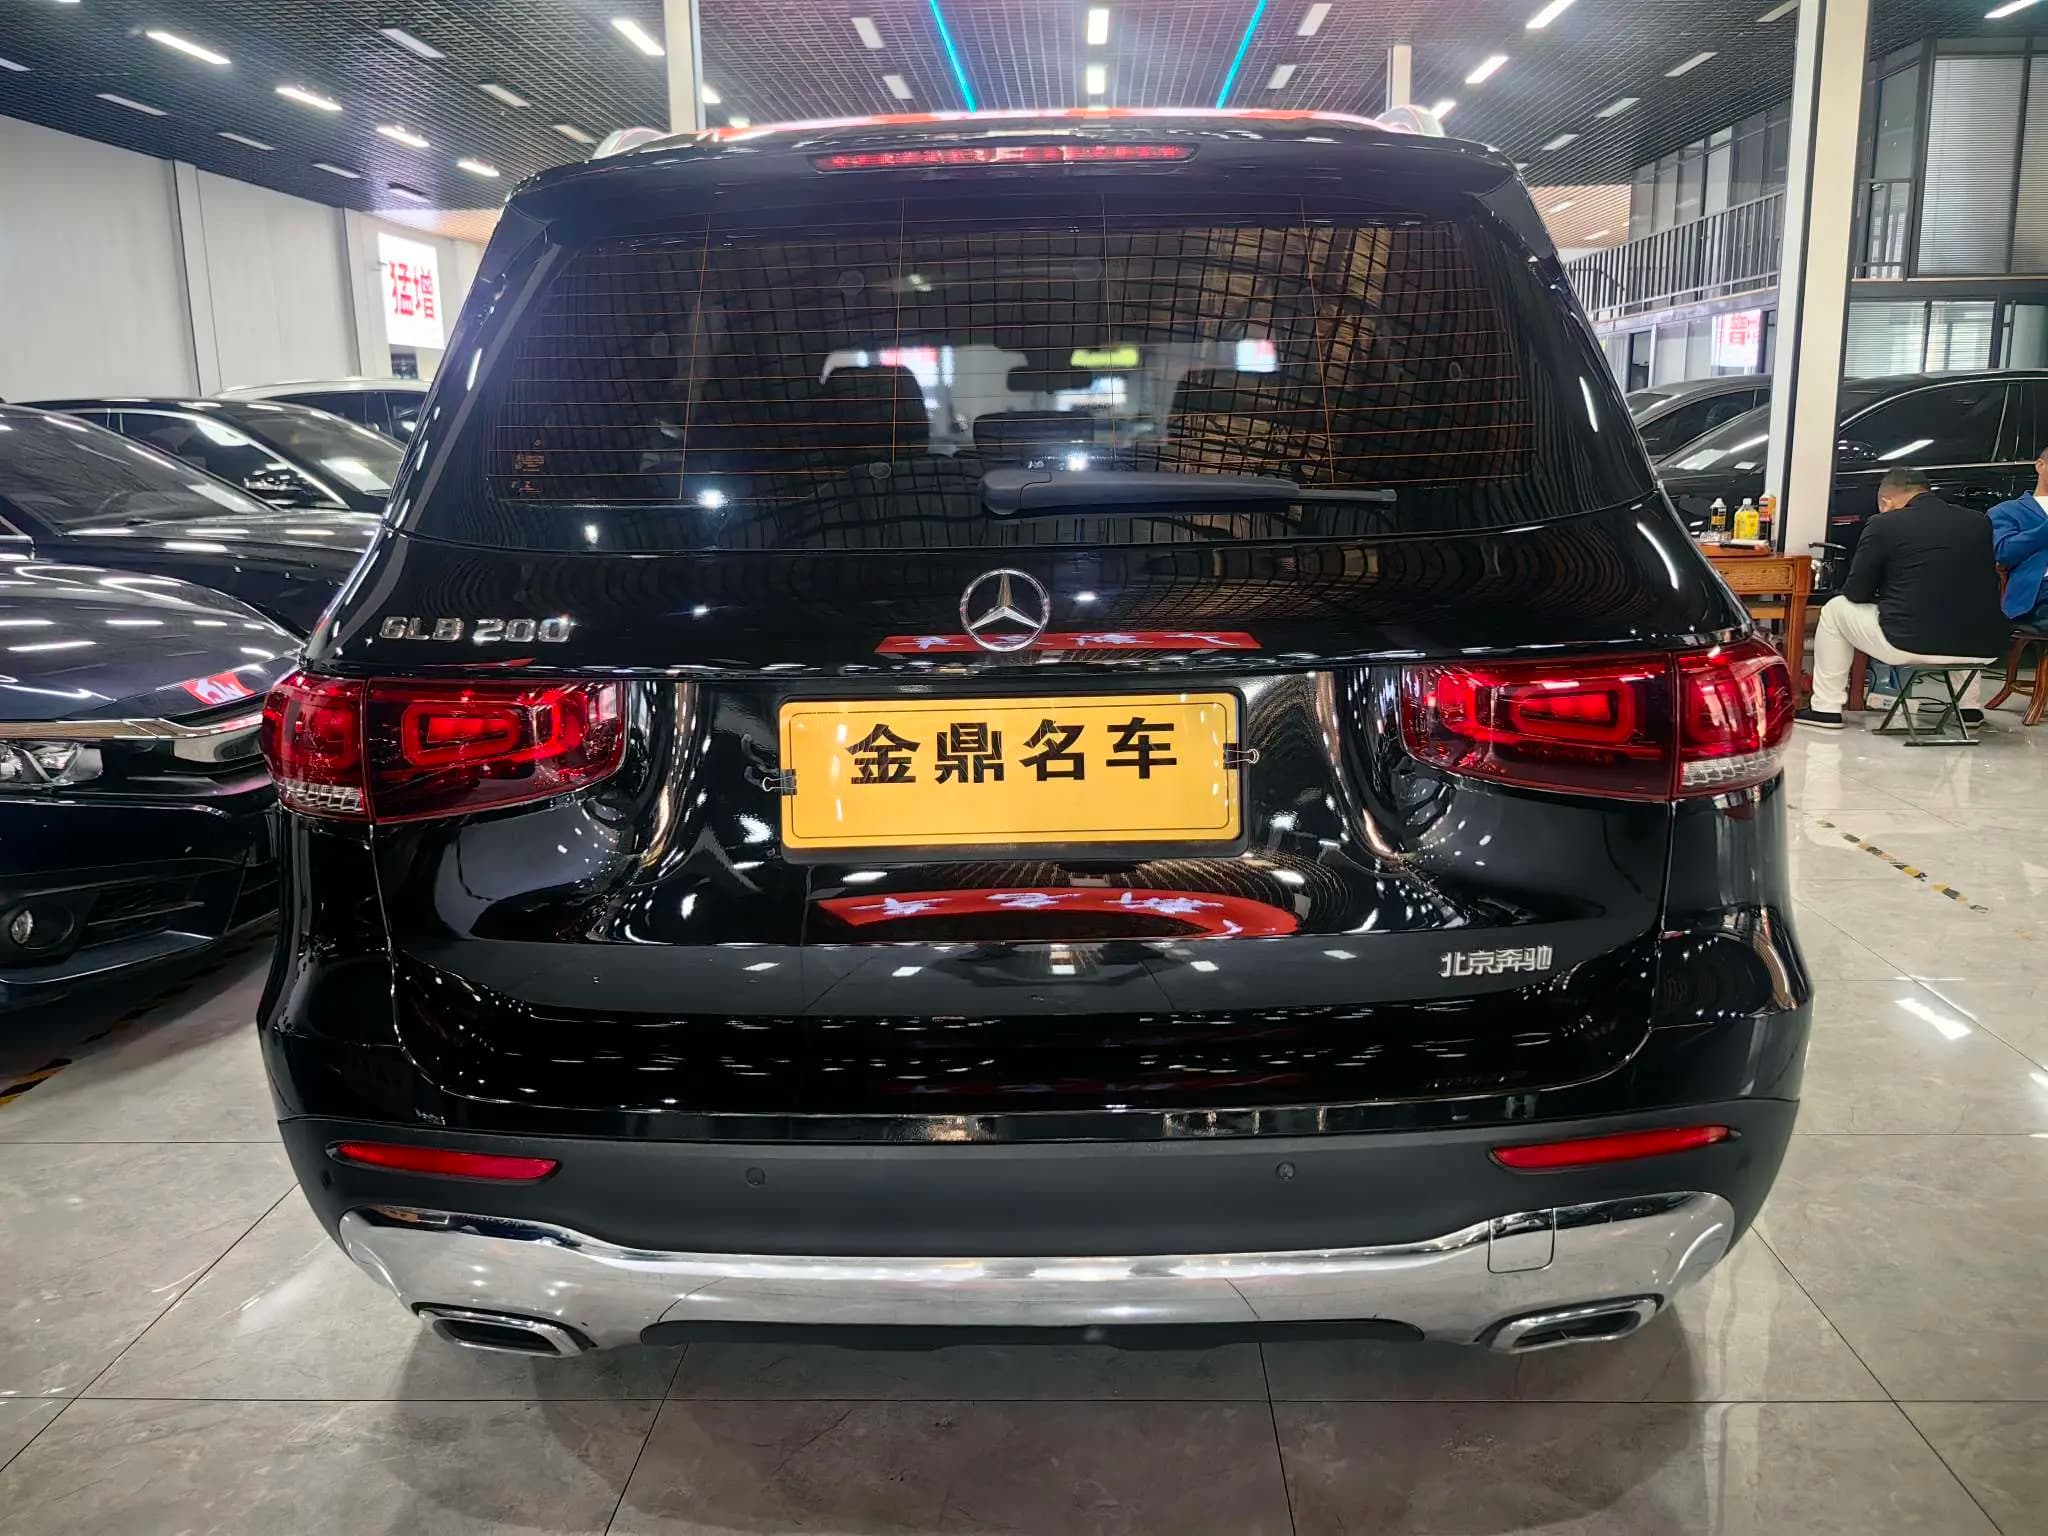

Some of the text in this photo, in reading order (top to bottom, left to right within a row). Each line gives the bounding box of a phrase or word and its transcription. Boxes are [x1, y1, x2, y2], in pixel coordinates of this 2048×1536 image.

[379, 616, 574, 644] GLB 200
[845, 716, 1178, 785] 金鼎名车
[1439, 944, 1553, 978] 北京奔驰
